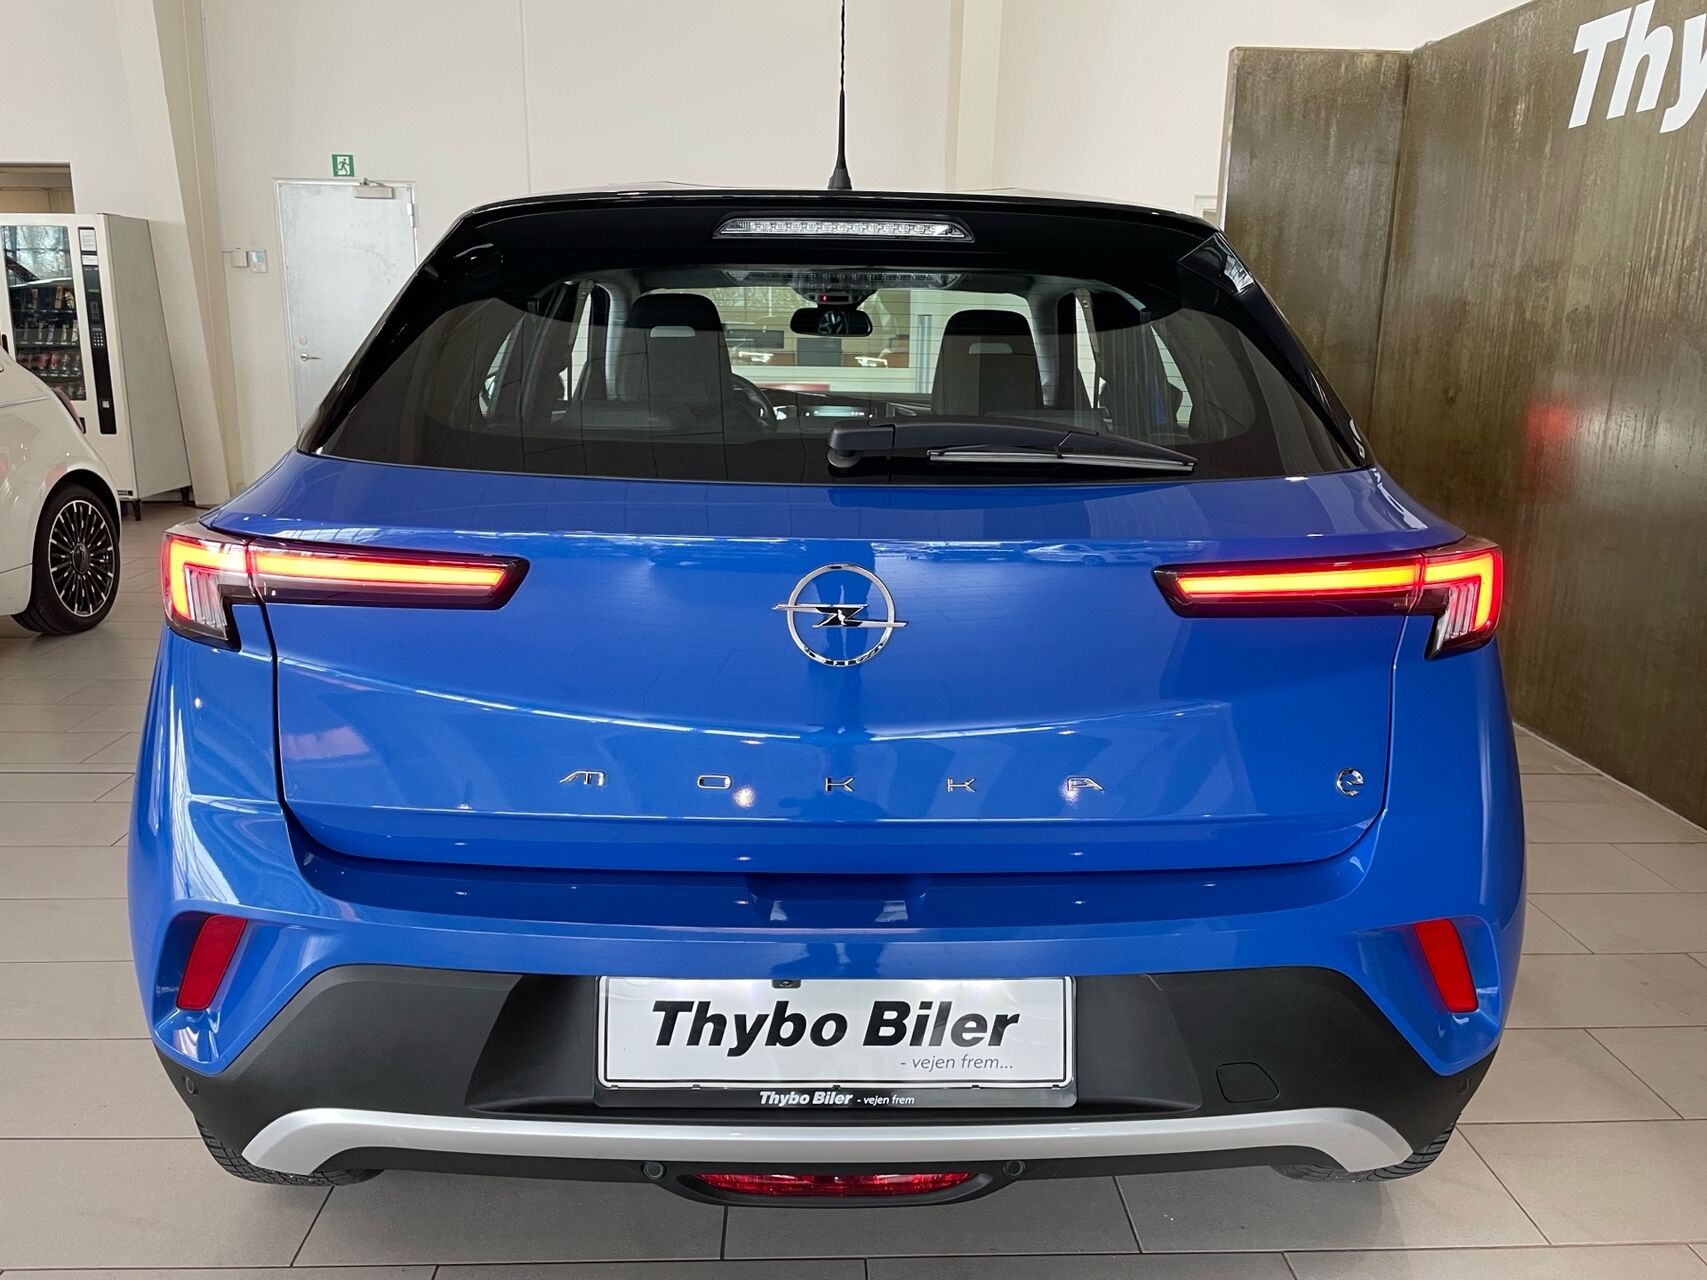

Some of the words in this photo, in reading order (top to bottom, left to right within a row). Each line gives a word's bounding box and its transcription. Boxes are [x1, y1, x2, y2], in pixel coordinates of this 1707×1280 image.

[559, 769, 1104, 793] MOKKA
[654, 1001, 847, 1057] Thybo
[863, 1001, 1021, 1048] Biler
[912, 1056, 955, 1073] vejen
[960, 1054, 1014, 1069] frem...
[759, 1091, 810, 1107] Thybo
[812, 1091, 854, 1105] Biler
[863, 1095, 889, 1107] vejen
[891, 1094, 915, 1105] frem
